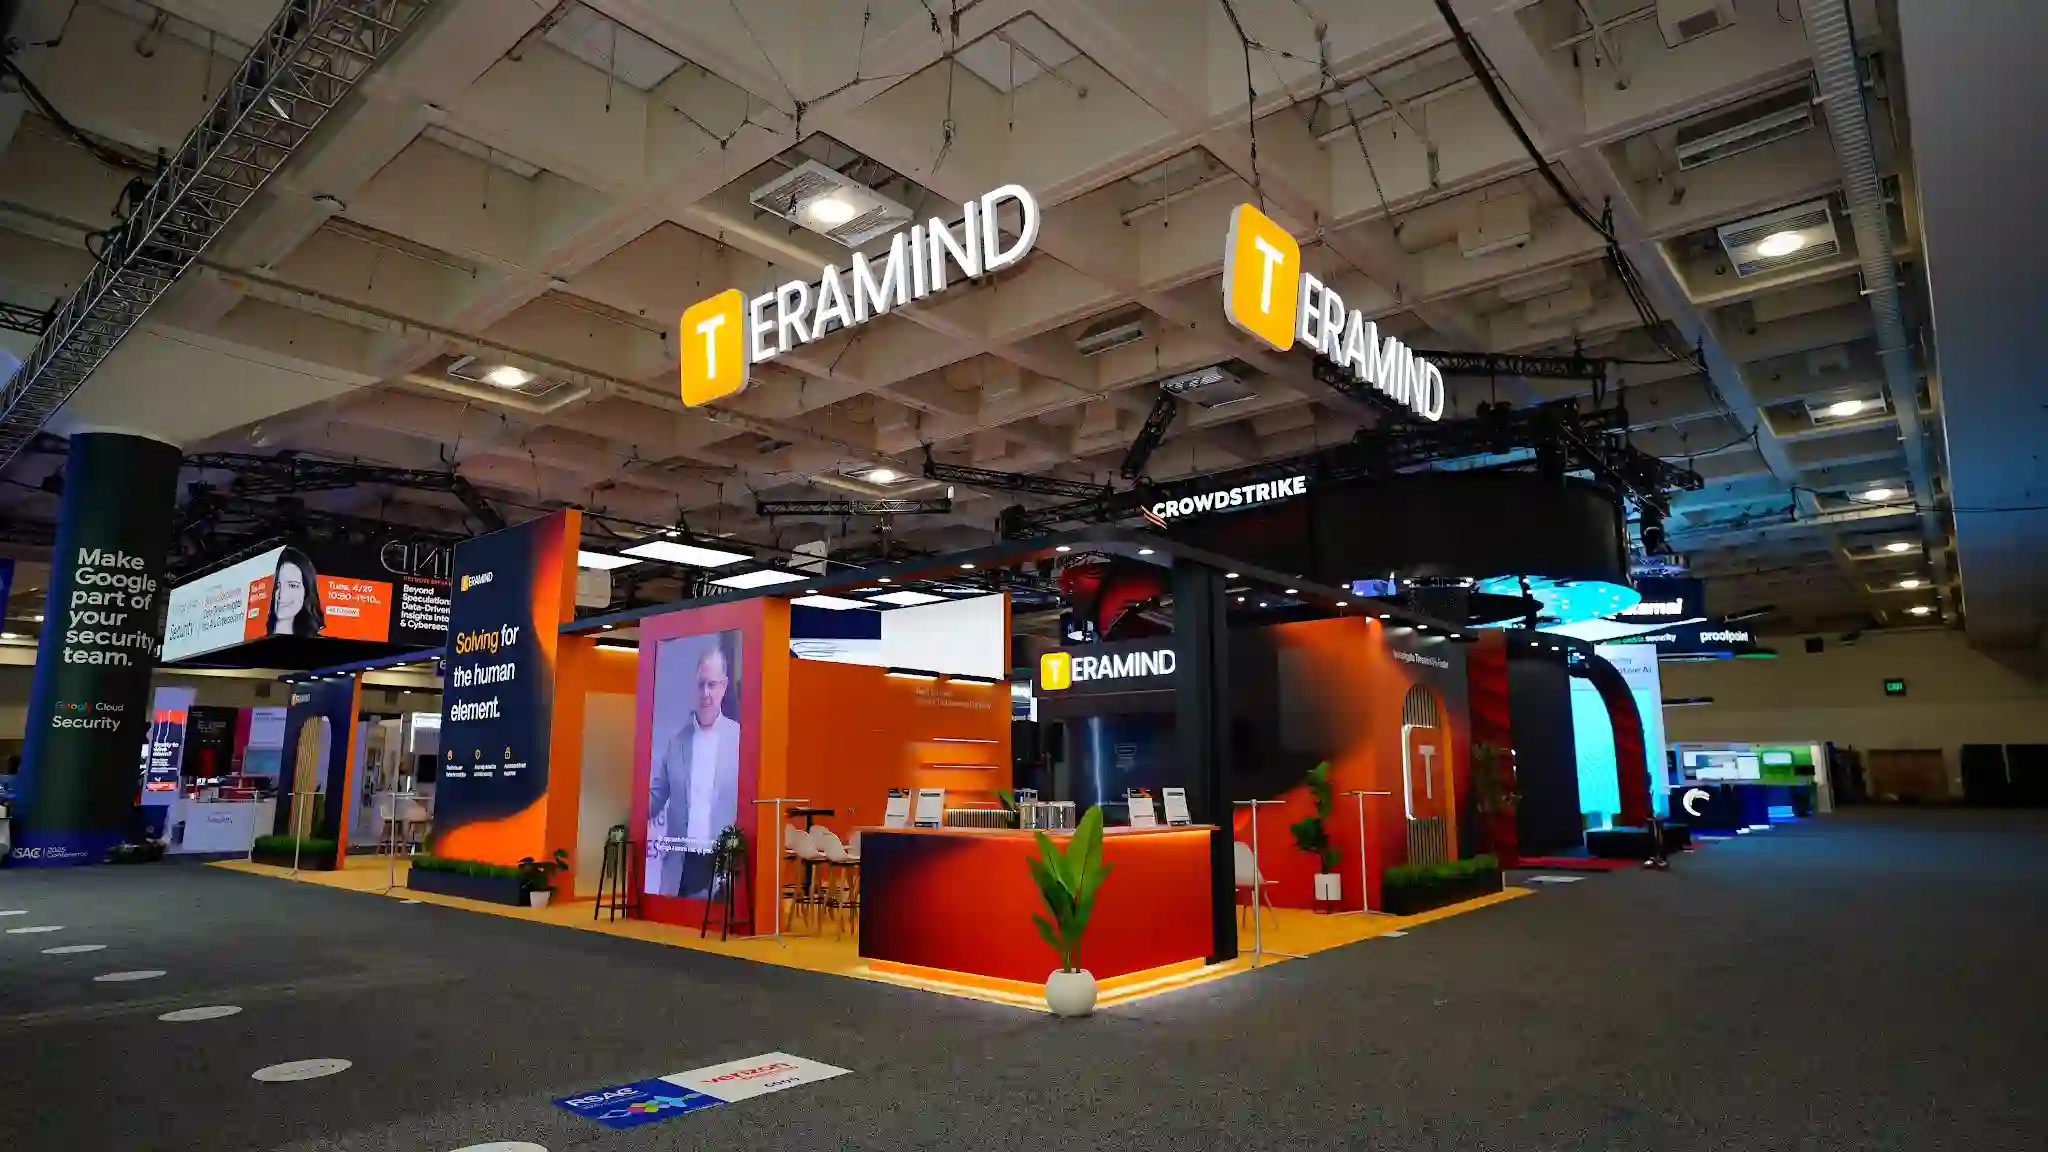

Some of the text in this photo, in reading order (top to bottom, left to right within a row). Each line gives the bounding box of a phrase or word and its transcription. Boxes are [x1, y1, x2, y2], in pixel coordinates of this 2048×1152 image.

[694, 184, 1041, 382] TERAMIND
[1252, 233, 1445, 421] TERAMIND
[1152, 475, 1307, 519] CROWDSTRIKE
[77, 547, 145, 571] Make
[75, 566, 157, 594] Google
[403, 584, 434, 596] Beyond
[70, 590, 127, 609] part
[130, 593, 153, 611] of
[401, 601, 451, 615] Data-Driven
[68, 610, 128, 629] your
[400, 611, 433, 622] Insights
[64, 629, 155, 655] security
[456, 624, 519, 654] Solving for
[1699, 629, 1749, 643] proofpoint
[62, 646, 133, 667] team.
[1046, 649, 1176, 684] TERAMIND
[453, 665, 472, 687] the
[474, 661, 516, 685] human
[95, 702, 125, 712] Cloud
[450, 696, 500, 722] element.
[52, 715, 121, 732] Security
[1418, 744, 1437, 800] T
[564, 1087, 640, 1107] RSAC
